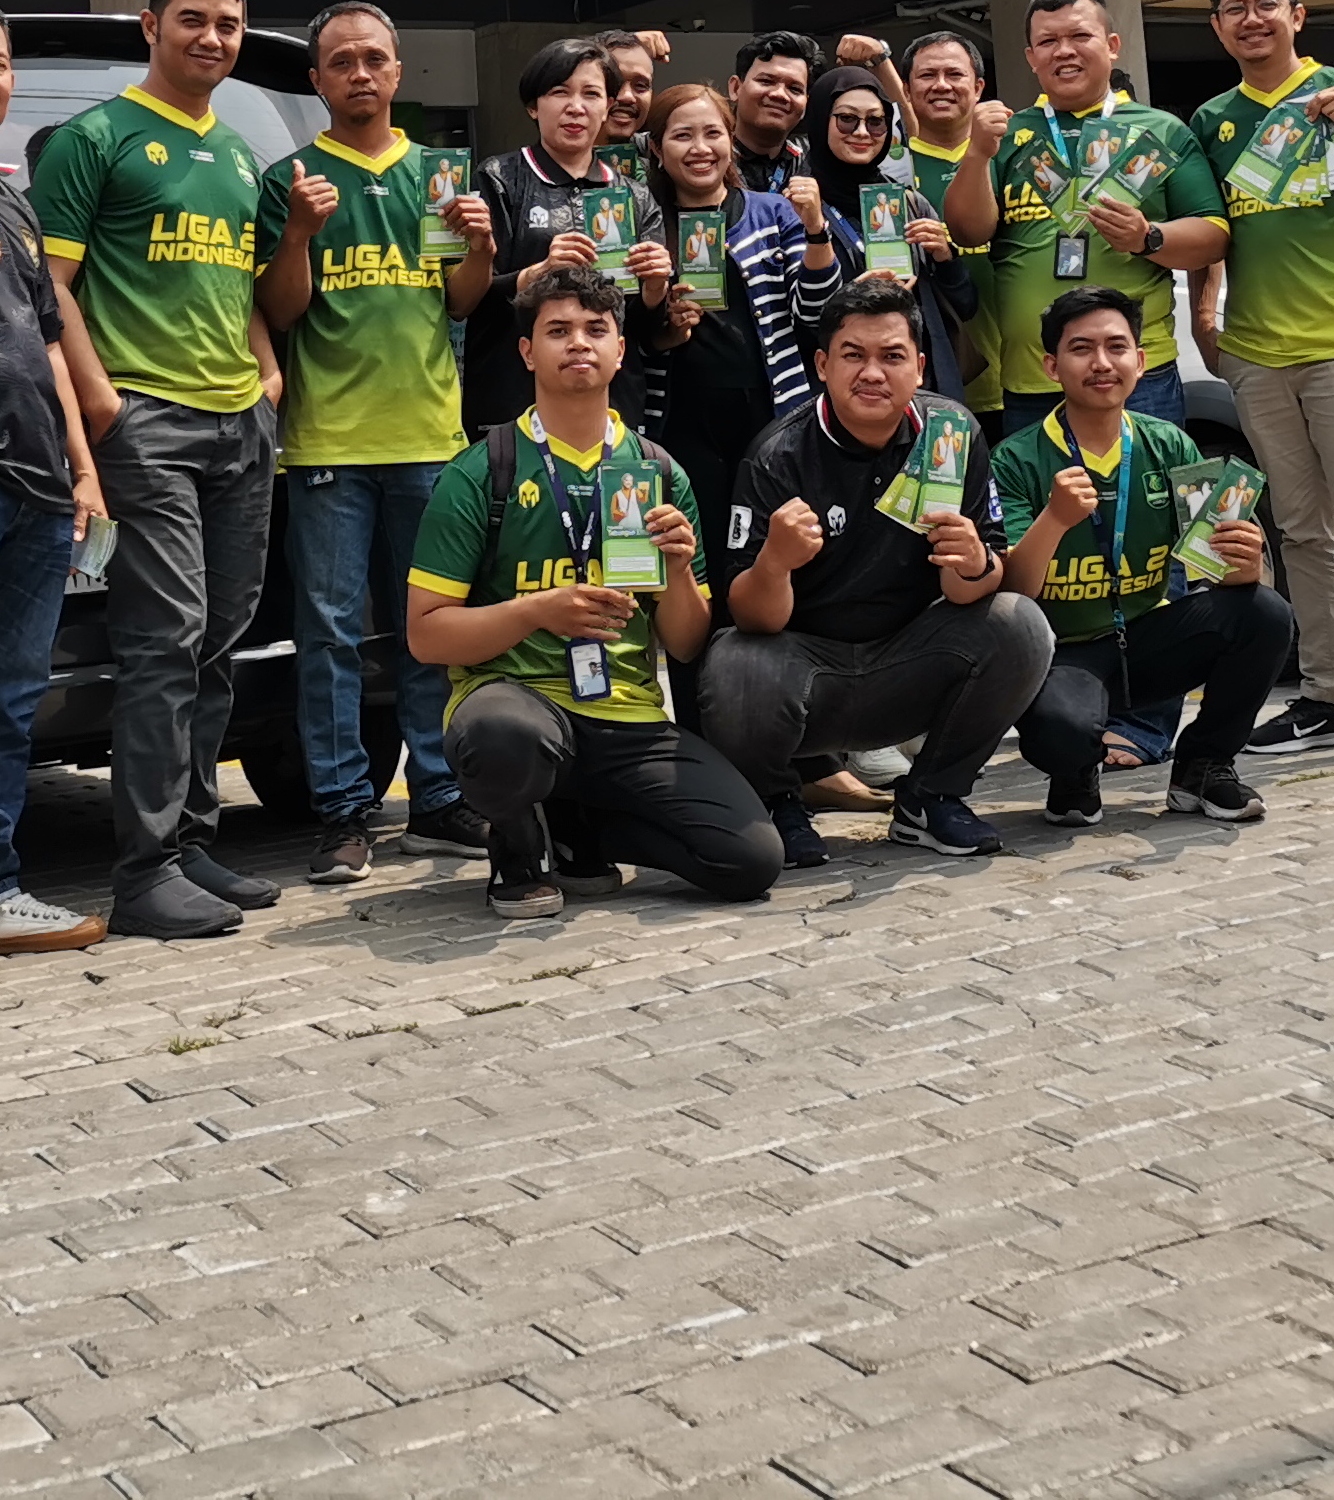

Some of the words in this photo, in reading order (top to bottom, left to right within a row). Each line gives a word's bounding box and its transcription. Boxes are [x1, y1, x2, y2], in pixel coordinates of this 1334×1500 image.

[150, 211, 234, 247] LIGA
[147, 242, 255, 272] INDONESA
[323, 243, 406, 274] LIGA
[321, 268, 443, 292] INDONESIA
[1146, 545, 1169, 572] 2
[516, 557, 603, 591] LIGA
